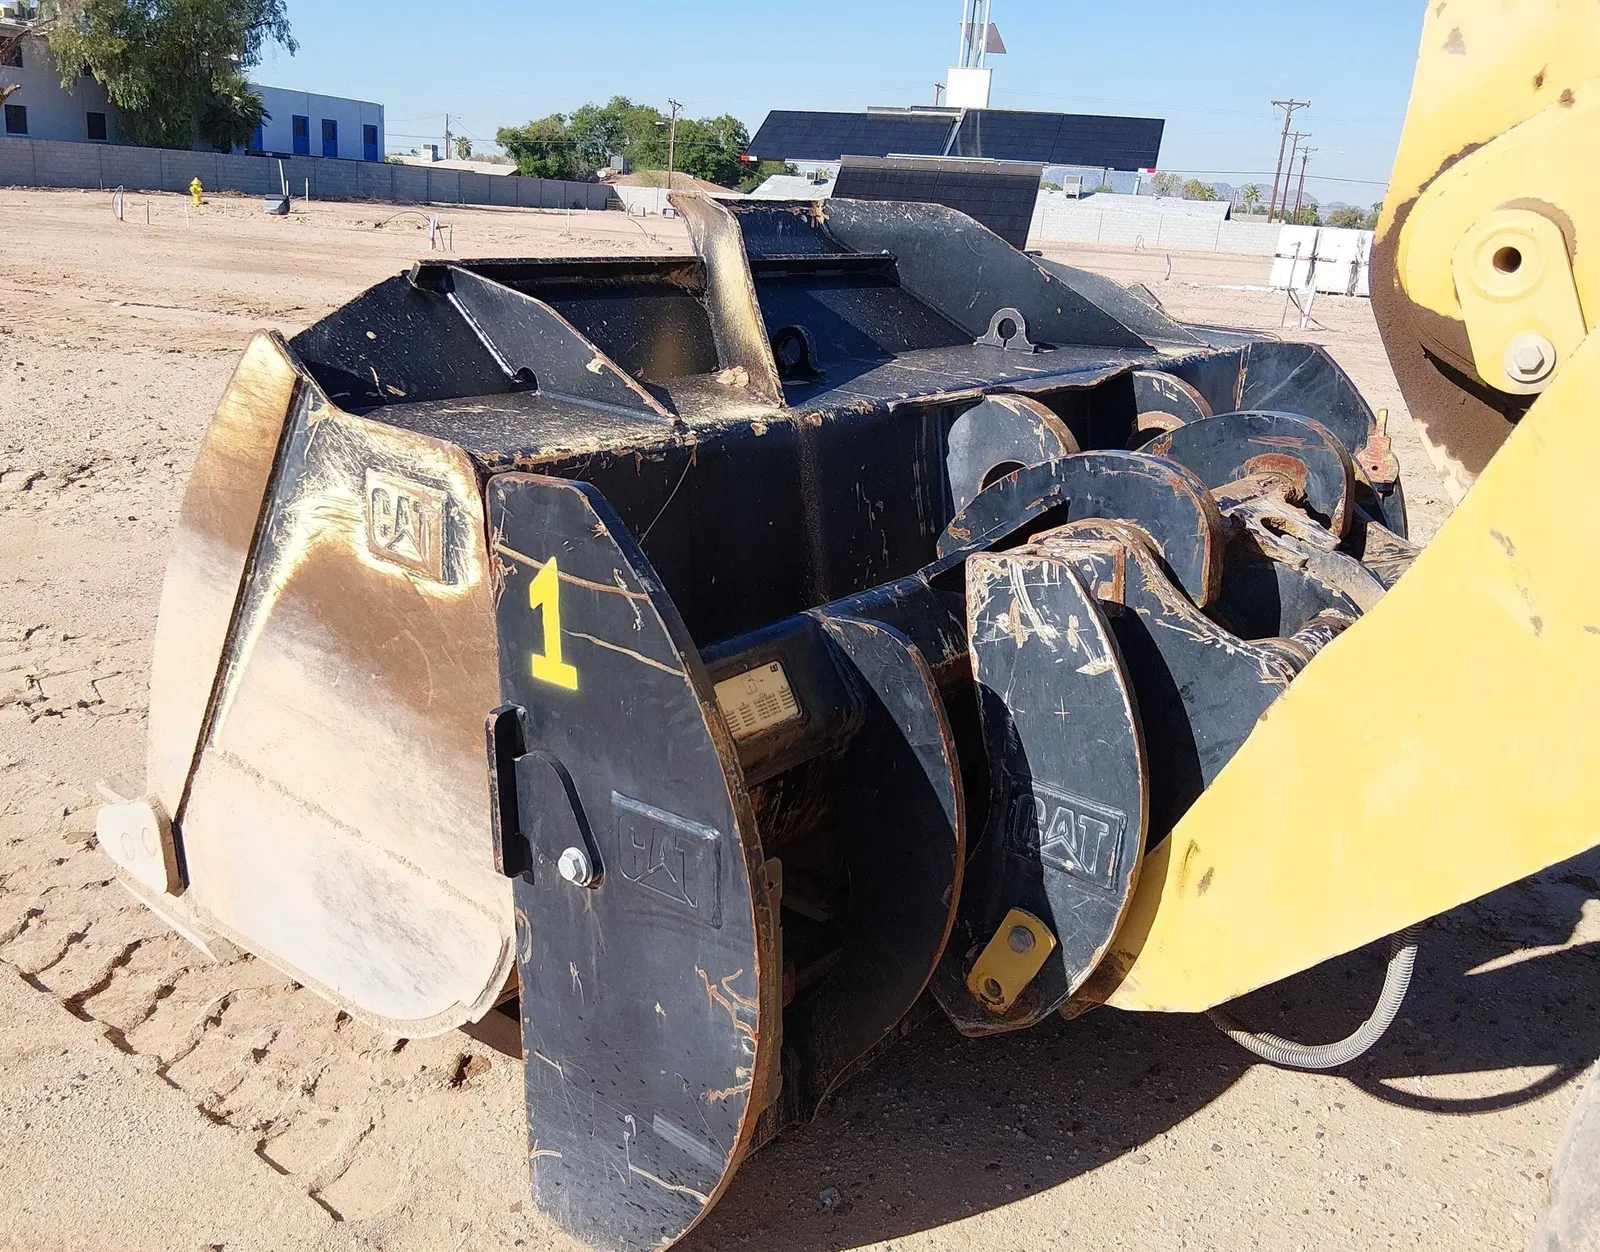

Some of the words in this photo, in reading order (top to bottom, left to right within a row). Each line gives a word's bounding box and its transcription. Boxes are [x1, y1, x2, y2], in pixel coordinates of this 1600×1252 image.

[370, 486, 432, 567] CAT
[529, 556, 578, 690] 1
[769, 663, 778, 672] CAT
[1013, 793, 1110, 876] CAT
